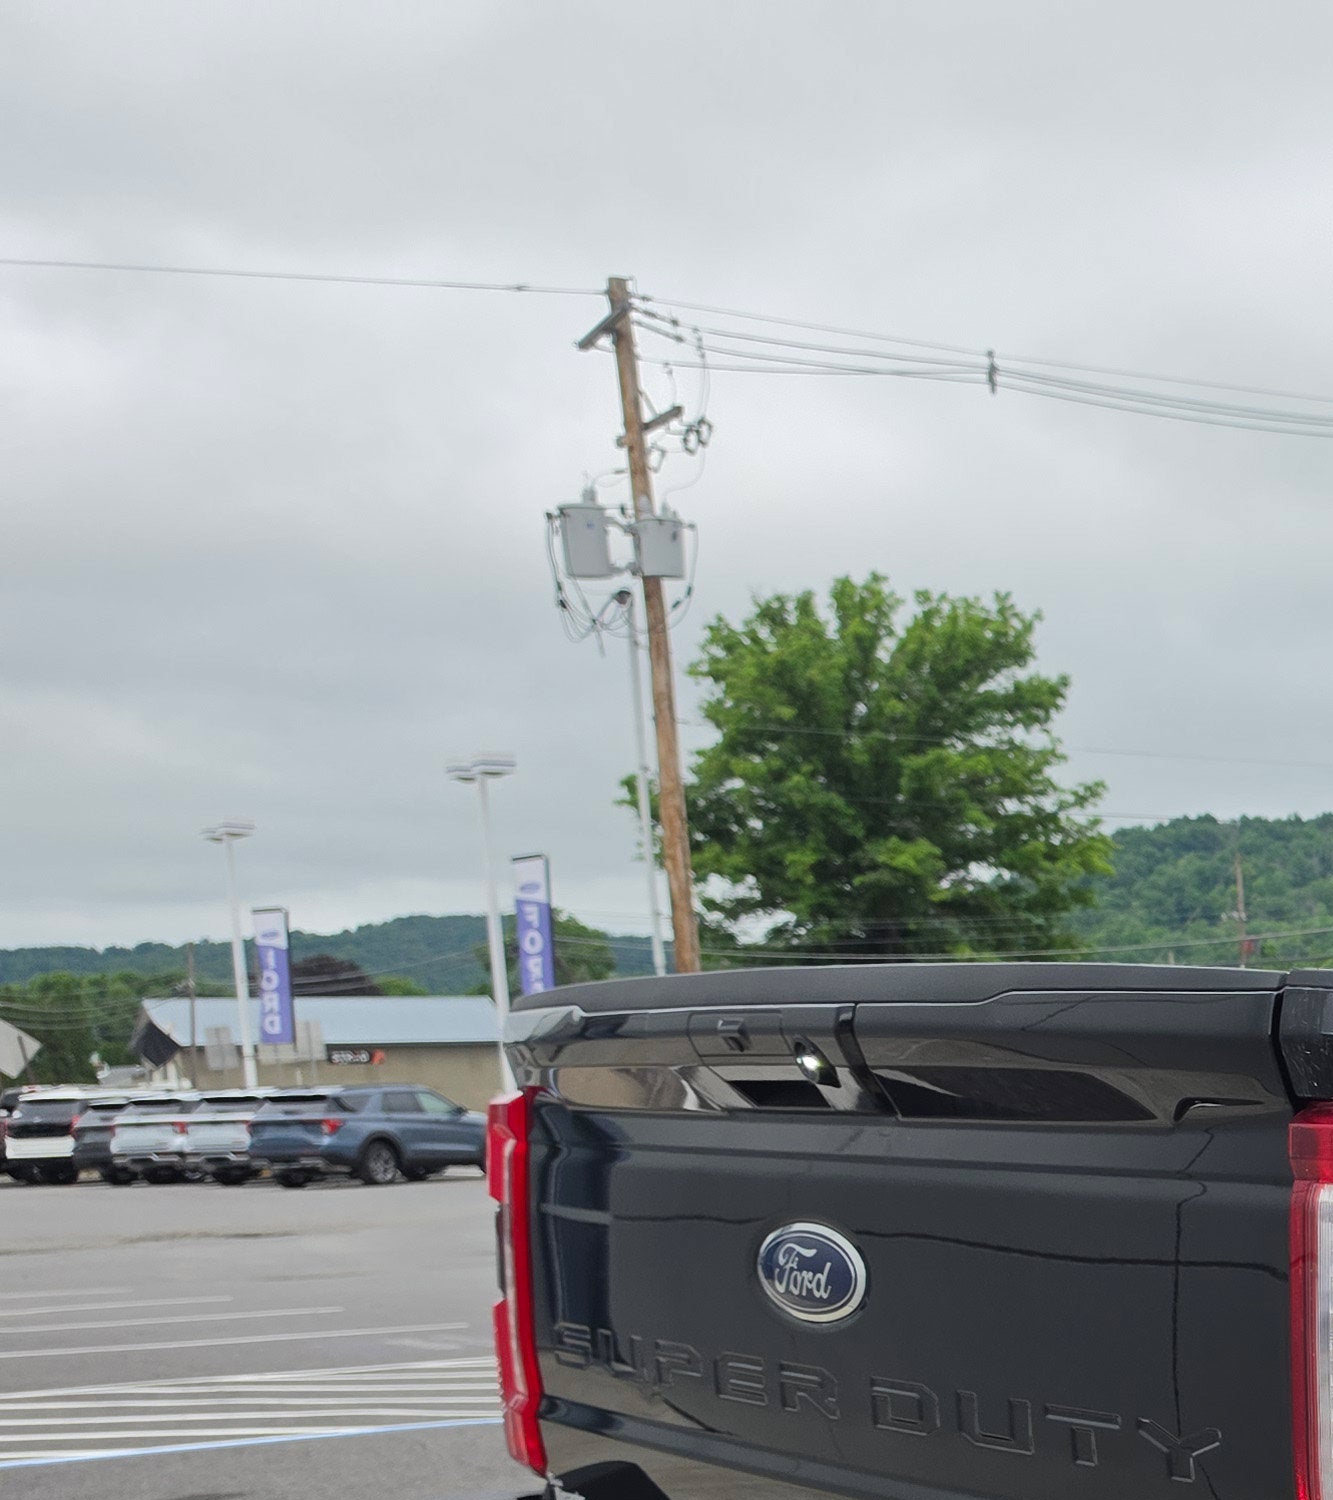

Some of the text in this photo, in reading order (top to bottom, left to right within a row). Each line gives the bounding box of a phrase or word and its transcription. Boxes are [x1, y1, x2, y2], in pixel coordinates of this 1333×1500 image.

[774, 1242, 832, 1300] Ford
[552, 1321, 1223, 1484] SUPER DUTY
